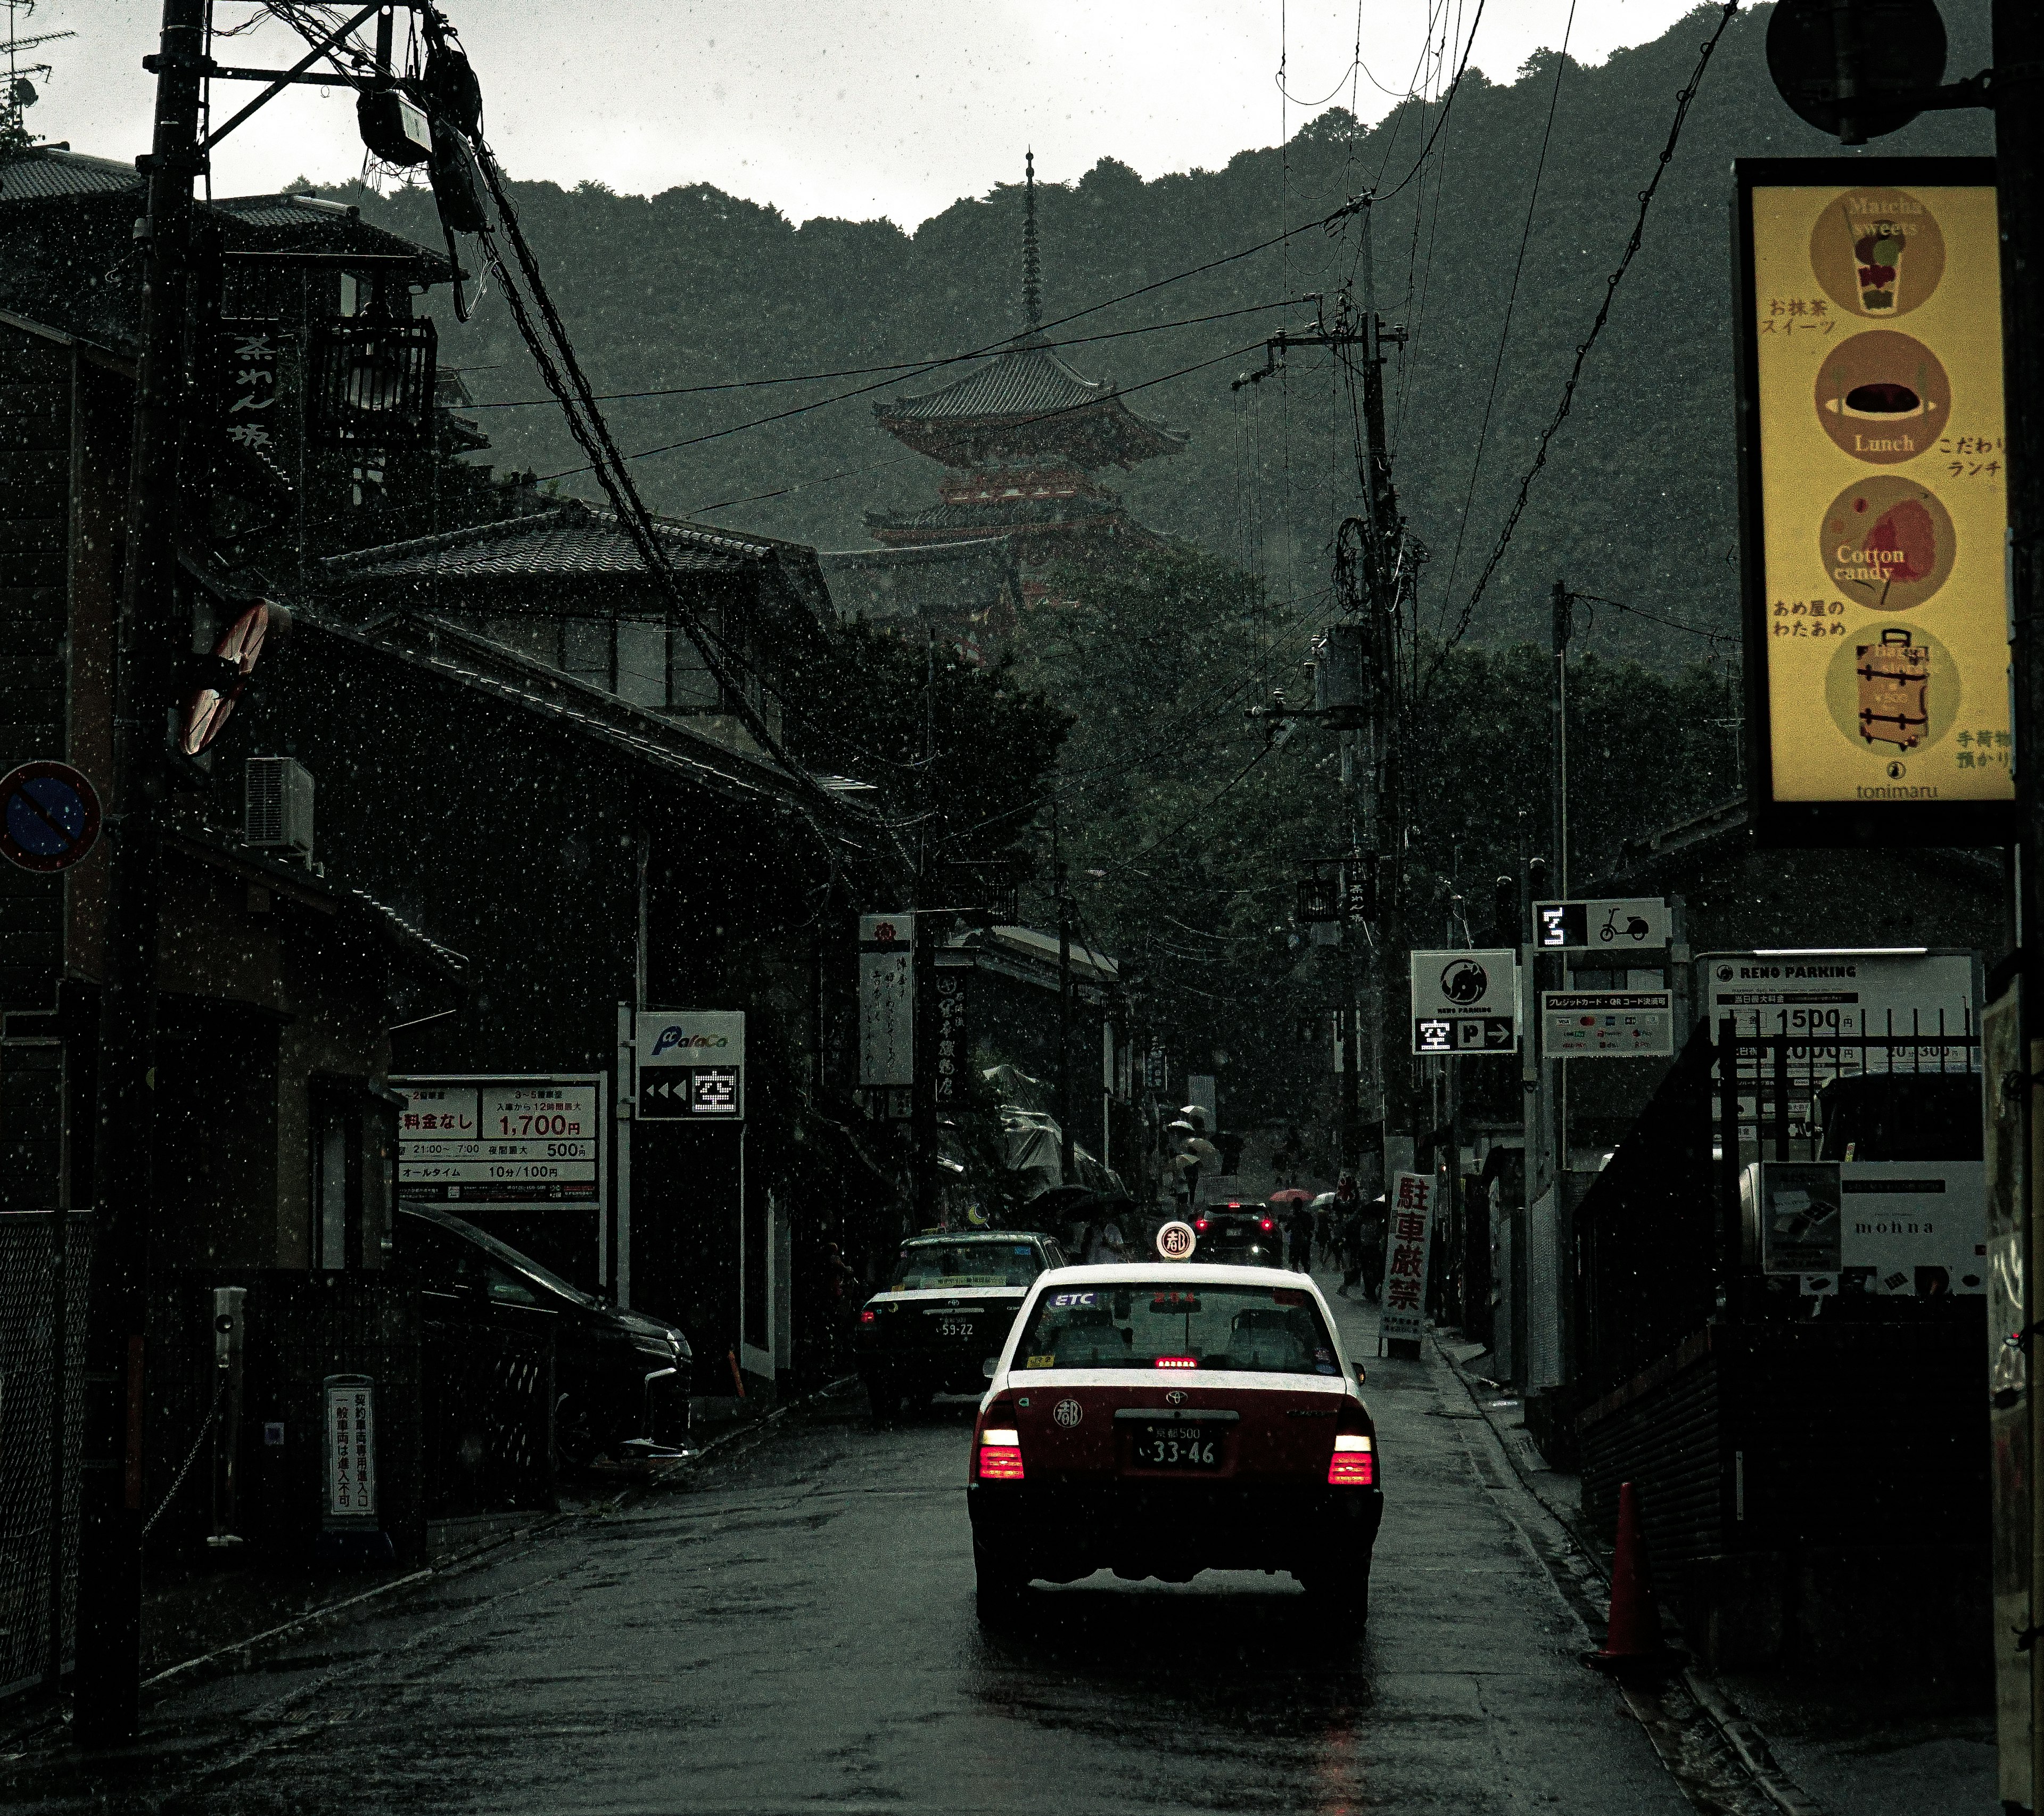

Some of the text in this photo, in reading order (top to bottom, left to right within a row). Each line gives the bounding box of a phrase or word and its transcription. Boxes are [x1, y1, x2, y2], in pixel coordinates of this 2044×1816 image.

[1849, 196, 1923, 215] Matcha
[1853, 221, 1918, 236] sweets
[1770, 298, 1827, 316] お抹茶
[1762, 319, 1835, 335] スイーツ
[227, 336, 277, 446] 茶わん坂
[1855, 434, 1915, 451] Lunch
[1948, 461, 2001, 477] ランチ
[1837, 545, 1905, 563] Cotton
[1834, 564, 1893, 583] candy
[1774, 600, 1844, 617] あめ屋の
[1774, 621, 1845, 637] わたあめ
[1956, 752, 2010, 768] 預かり
[1857, 785, 1939, 798] tonimaru
[1543, 907, 1564, 945] 3
[1741, 966, 1856, 979] RENO PARKING
[1420, 1020, 1450, 1050] 空
[1463, 1025, 1479, 1043] P
[695, 1070, 734, 1110] 空
[535, 1103, 581, 1111] 12時間最大
[399, 1114, 473, 1129] 料金なし
[500, 1115, 580, 1136] 1,700円
[489, 1146, 528, 1155] 夜間最大
[403, 1166, 558, 1177] オールタイム 10分/100円
[1856, 1221, 1933, 1234] mohna
[1388, 1177, 1430, 1310] 駐車厳禁
[1055, 1293, 1094, 1306] ETC
[943, 1324, 973, 1335] 59-22
[336, 1398, 350, 1507] 一般車両は進入不可
[355, 1394, 368, 1507] 契約車両専用進入口
[1153, 1441, 1215, 1463] 33-46
